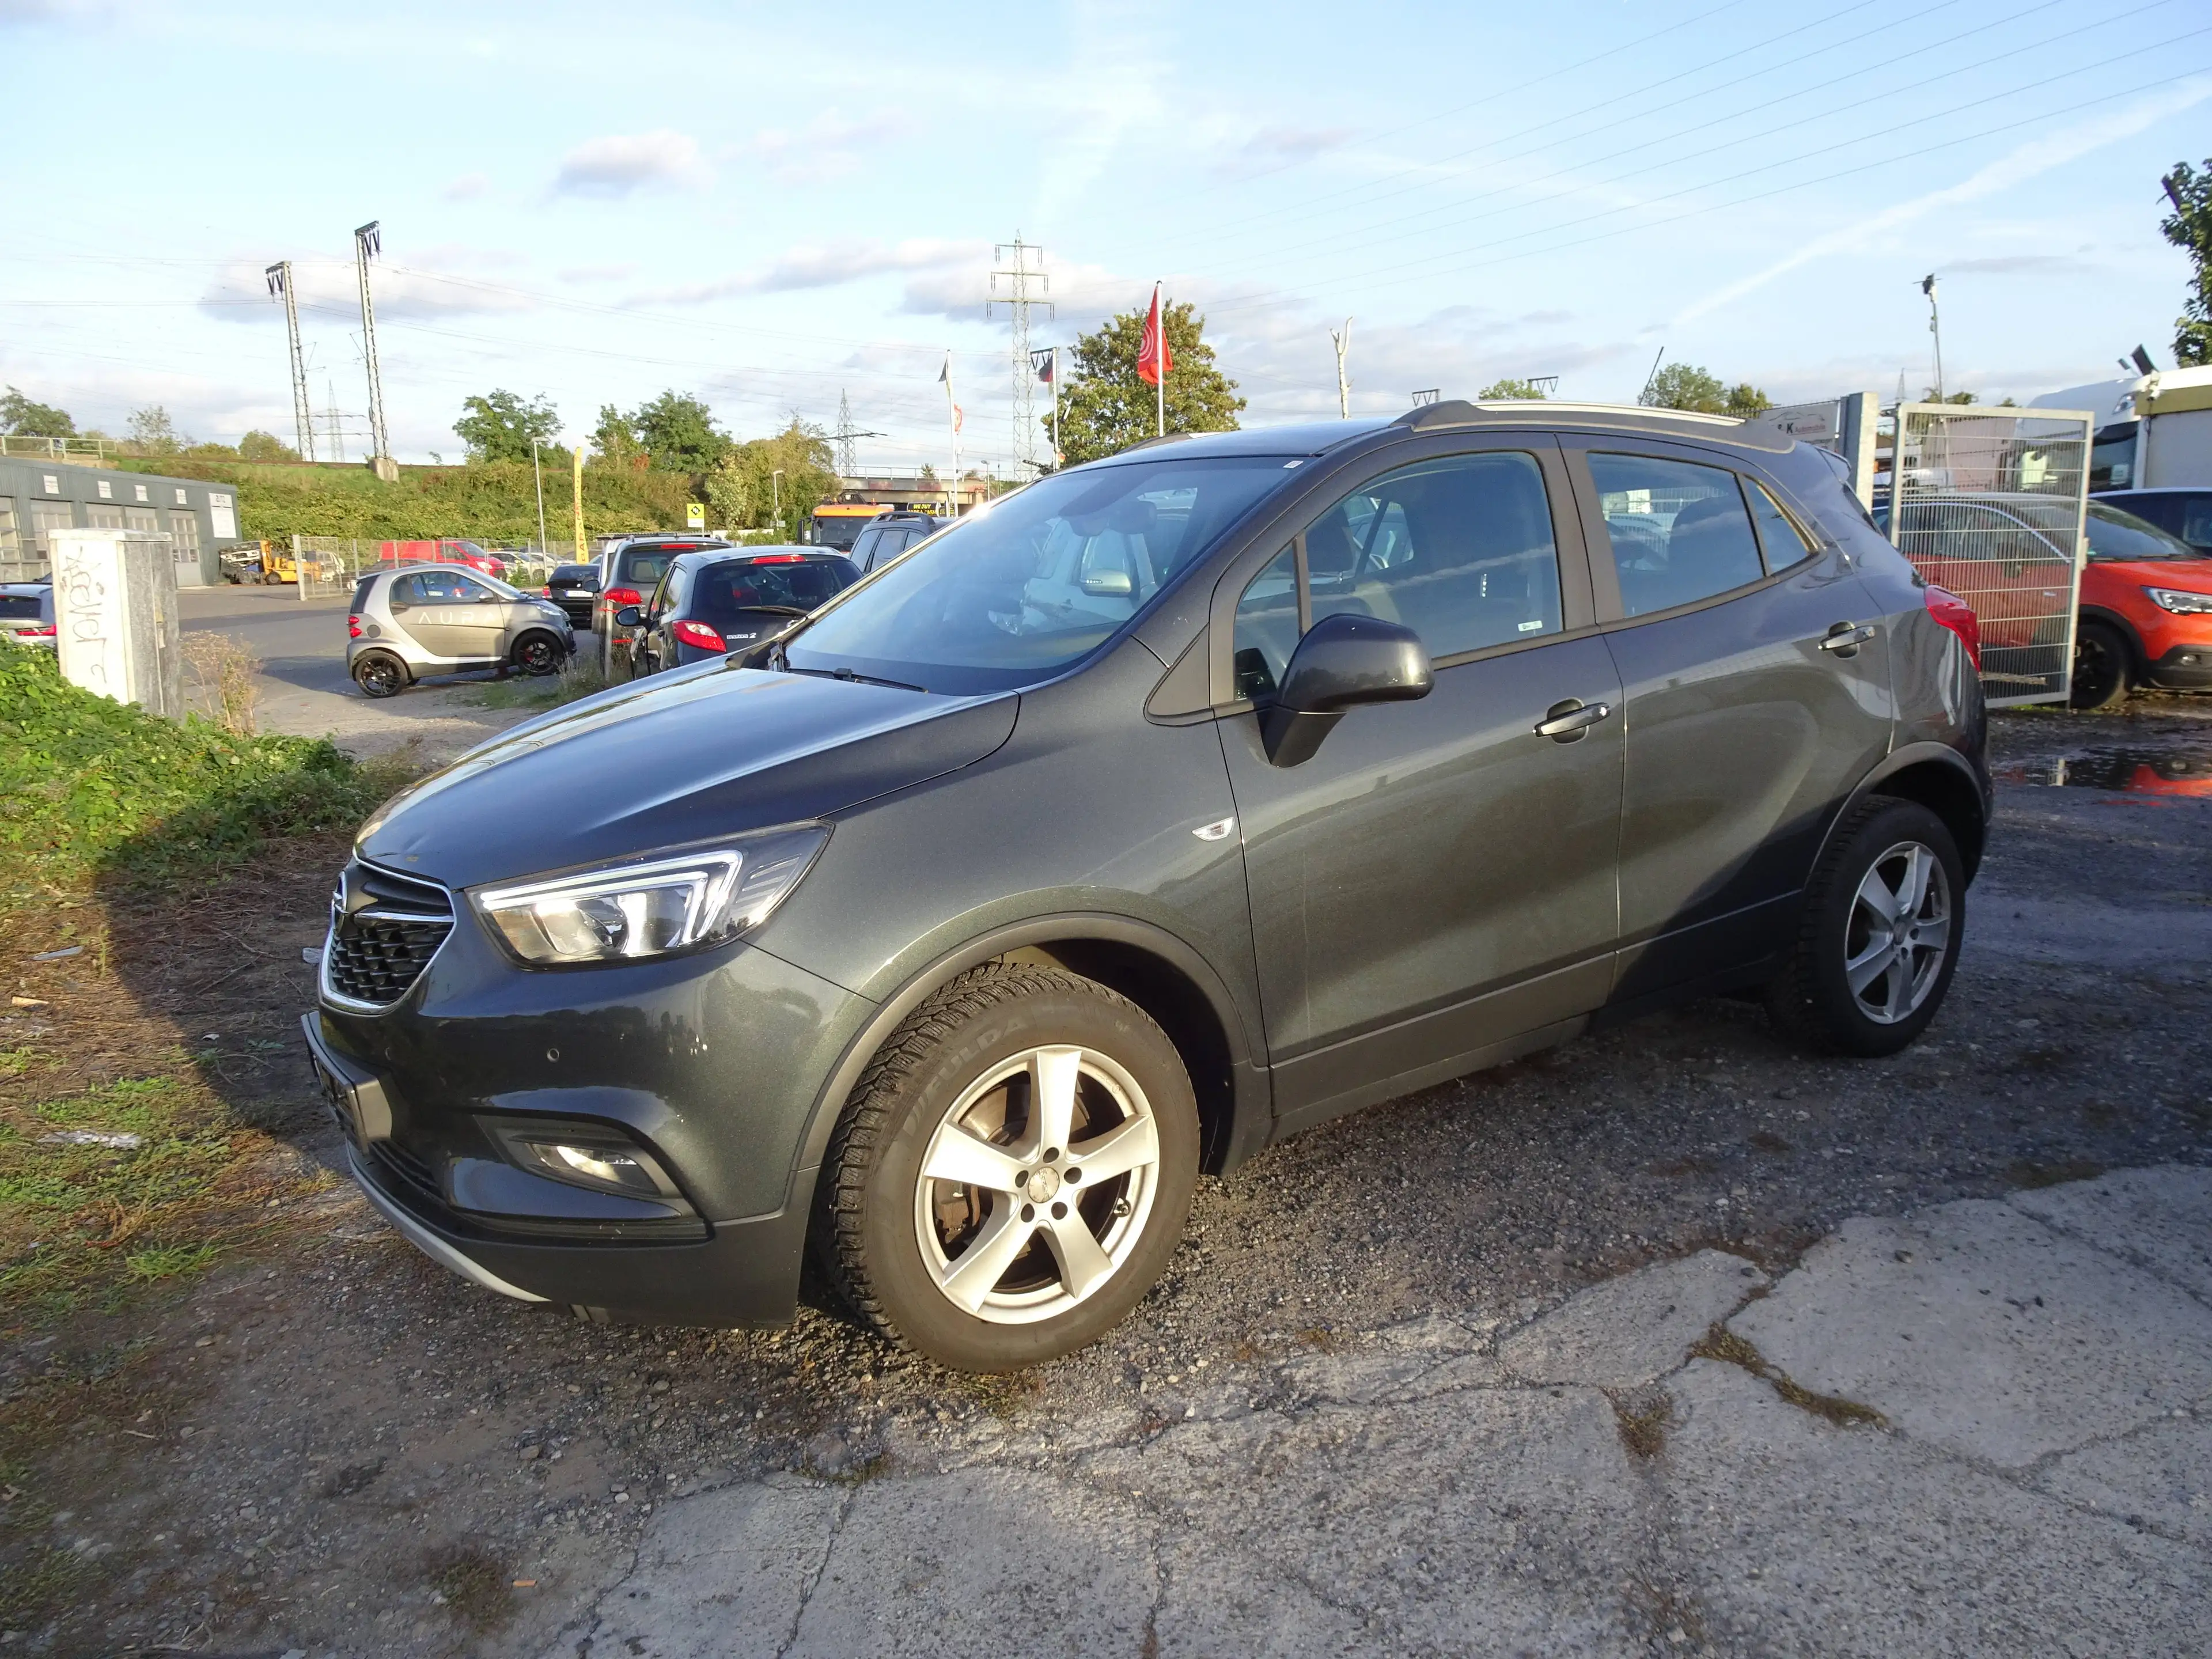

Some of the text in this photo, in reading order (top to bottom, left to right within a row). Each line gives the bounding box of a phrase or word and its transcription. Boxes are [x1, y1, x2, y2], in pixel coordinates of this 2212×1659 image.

[1786, 422, 1794, 434] K
[418, 611, 496, 626] AURA
[924, 1017, 1029, 1099] FULDA
